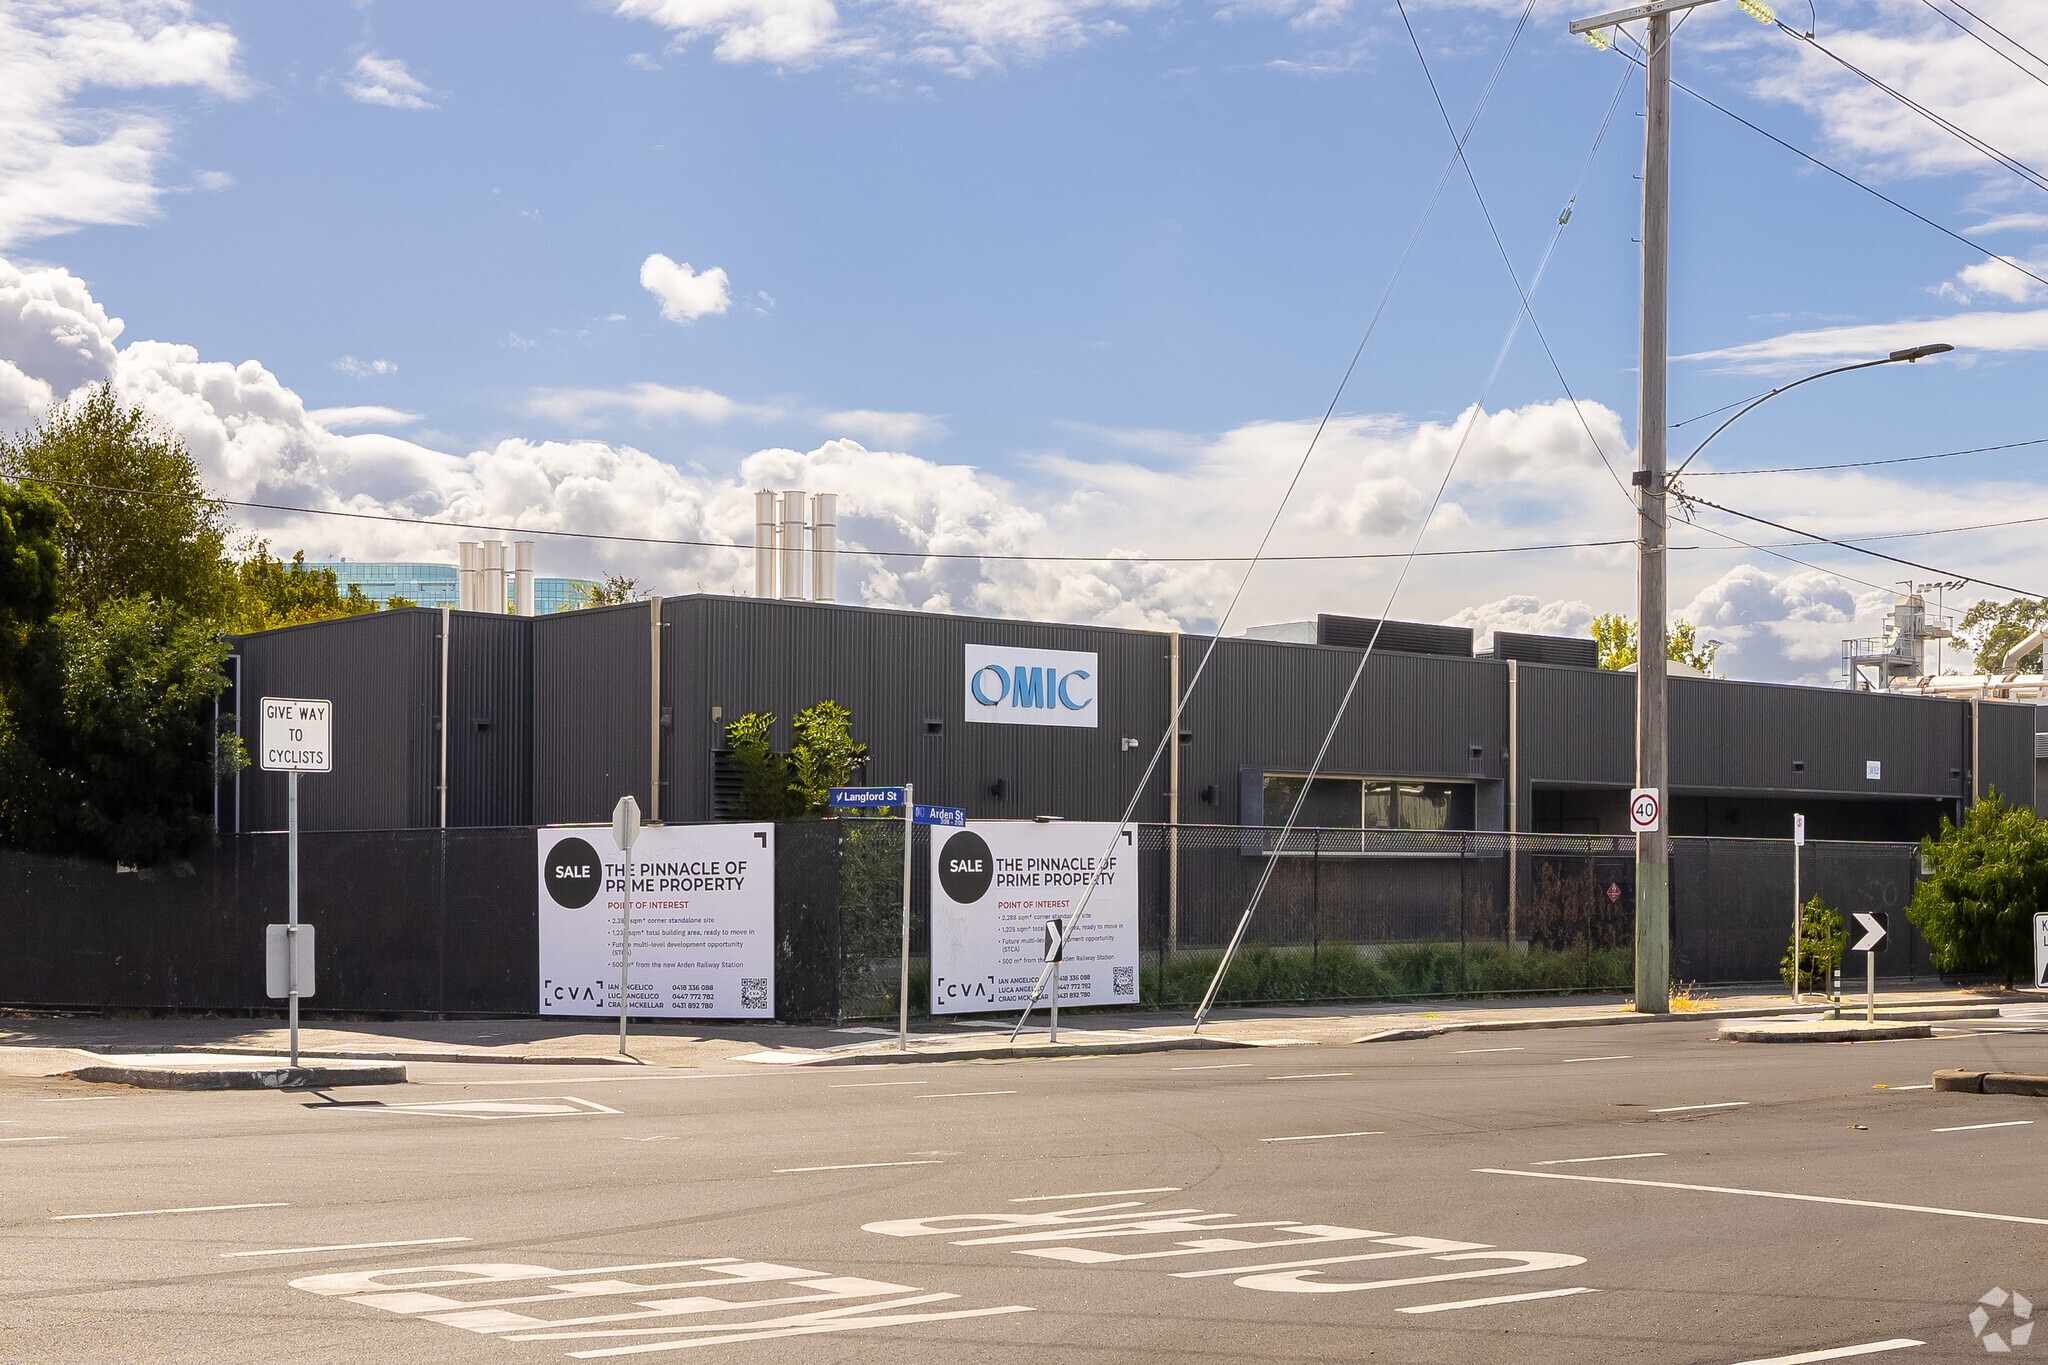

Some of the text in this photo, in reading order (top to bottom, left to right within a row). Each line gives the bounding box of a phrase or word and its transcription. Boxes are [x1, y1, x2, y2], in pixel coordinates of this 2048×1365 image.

[971, 664, 1093, 710] OMIC
[267, 705, 325, 721] GIVE WAY
[288, 728, 303, 742] TO
[268, 749, 324, 764] CYCLISTS
[844, 791, 897, 803] Langford St
[929, 807, 964, 821] Arden St
[1635, 803, 1653, 817] 40
[640, 861, 720, 877] PINNACLE
[725, 860, 748, 875] OF
[949, 859, 983, 873] SALE
[996, 858, 1023, 872] THE
[1027, 857, 1096, 872] PINNACLE
[555, 865, 591, 879] SALE
[606, 876, 745, 893] PRME PROPERTY
[997, 873, 1041, 888] PRIME
[607, 900, 690, 910] POIT OF INTEREST
[997, 900, 1070, 909] POINT OF INTEREST
[612, 917, 625, 925] 2,28
[668, 916, 702, 924] standalone
[703, 916, 715, 924] site
[612, 929, 624, 937] 1,23
[662, 928, 686, 938] building
[703, 928, 720, 937] ready
[1085, 935, 1115, 943] opportunity
[633, 940, 666, 948] multi-level
[667, 940, 706, 949] development
[707, 940, 744, 949] opportunity
[1002, 945, 1021, 954] (STCA)
[1076, 954, 1096, 962] Railway
[1096, 953, 1115, 961] Station
[635, 960, 651, 968] from
[677, 961, 696, 969] Arden
[696, 961, 720, 970] Railway
[1010, 976, 1040, 984] ANGELICO
[554, 986, 595, 1001] CVA
[947, 983, 986, 998] CVA
[998, 995, 1017, 1003] CRAIG
[860, 1201, 1588, 1294] CLEAR
[287, 1256, 1038, 1359] KEEP
